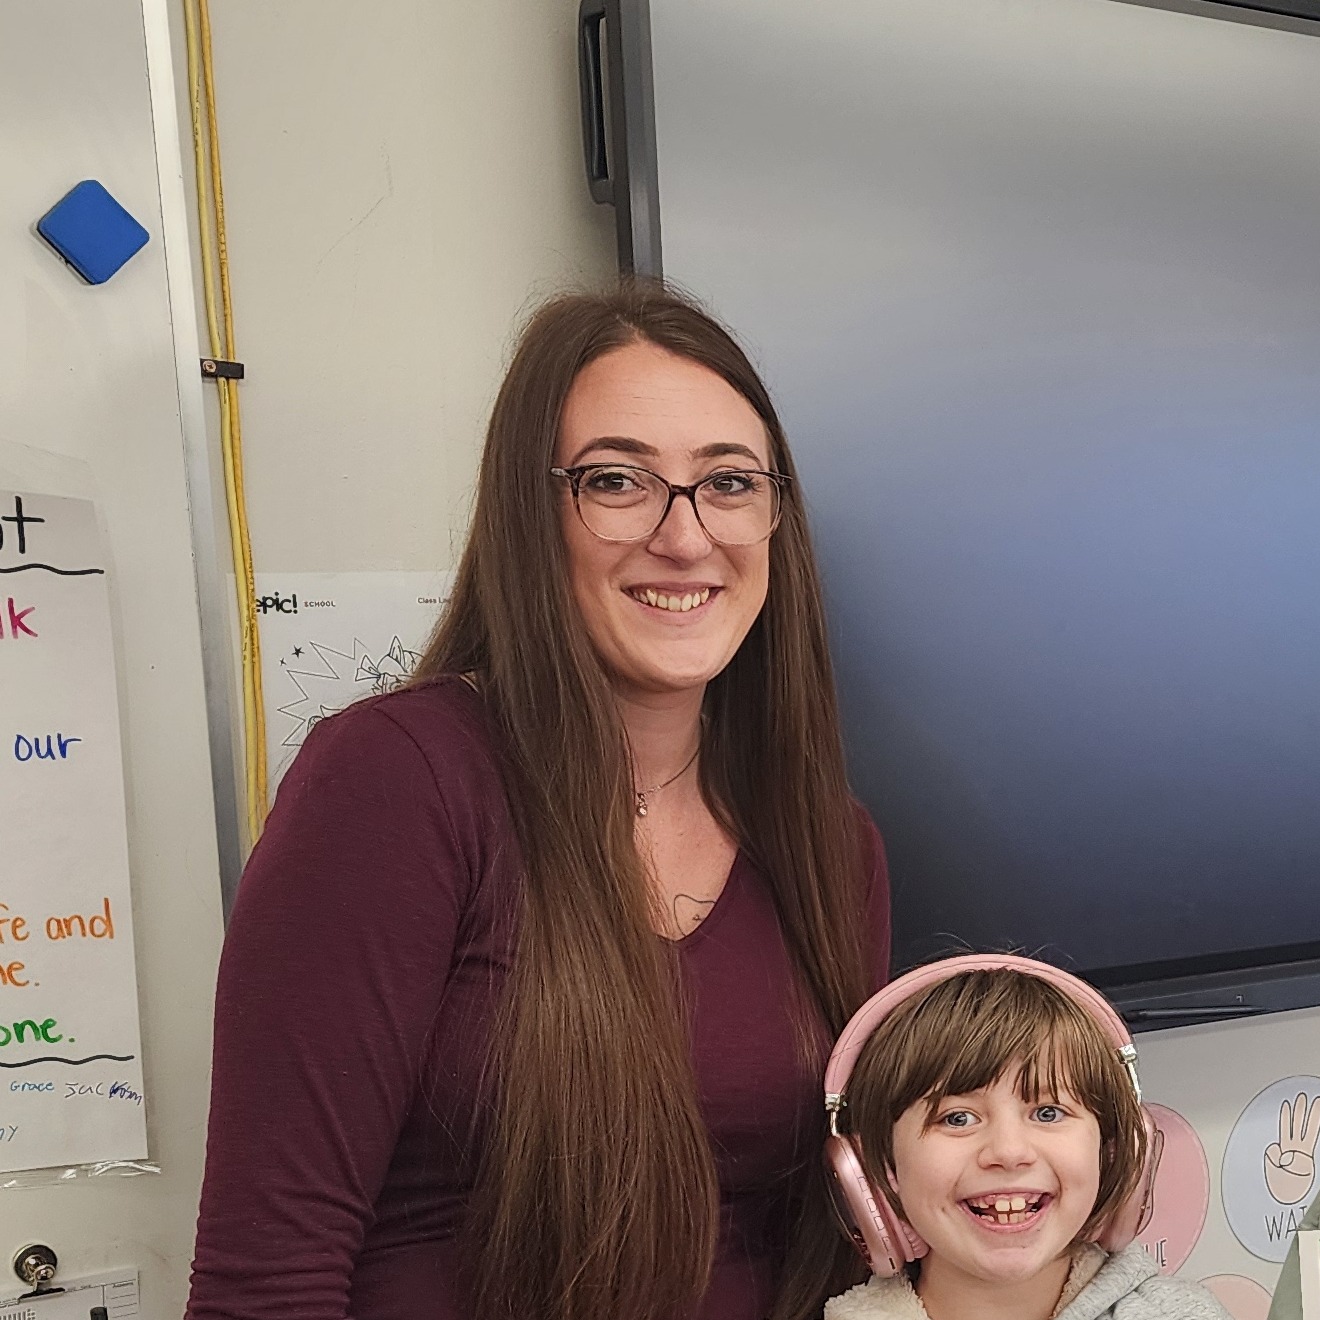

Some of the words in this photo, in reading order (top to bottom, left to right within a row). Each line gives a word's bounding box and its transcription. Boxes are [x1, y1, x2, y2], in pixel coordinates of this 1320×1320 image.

[304, 600, 336, 608] SCHOOL
[15, 733, 82, 761] our
[46, 897, 114, 940] and
